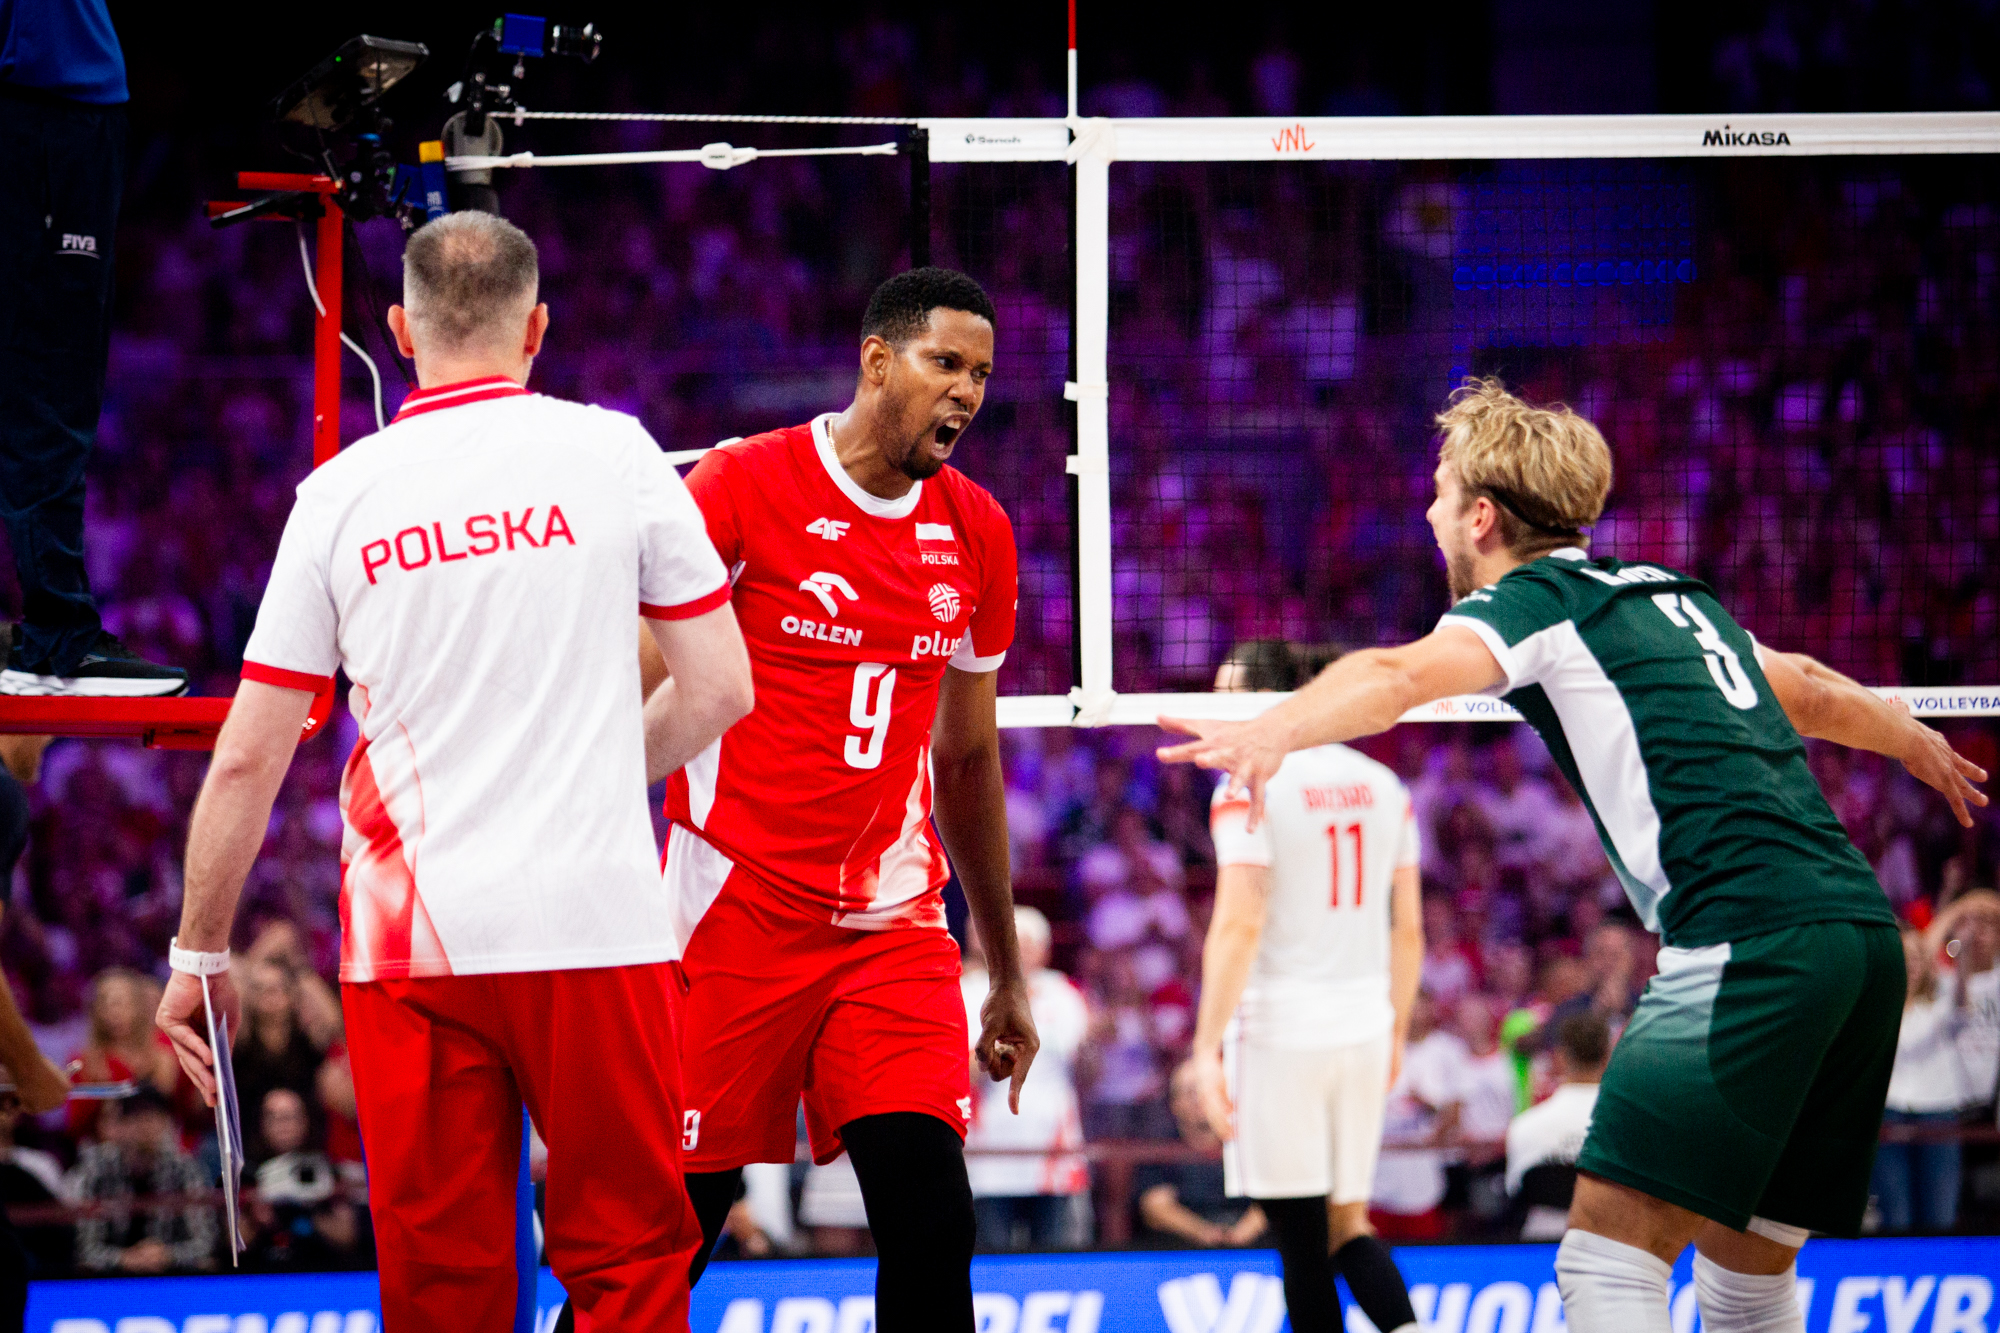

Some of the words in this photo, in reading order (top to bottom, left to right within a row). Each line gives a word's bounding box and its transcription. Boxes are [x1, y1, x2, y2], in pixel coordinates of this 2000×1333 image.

[1270, 124, 1315, 153] VNL
[361, 504, 576, 586] POLSKA
[806, 517, 850, 541] 4F
[921, 554, 959, 566] POLSKA
[781, 615, 863, 647] ORLEN
[1651, 593, 1758, 710] 3
[844, 662, 896, 769] 9
[1325, 822, 1363, 907] 11
[682, 1109, 701, 1151] 9
